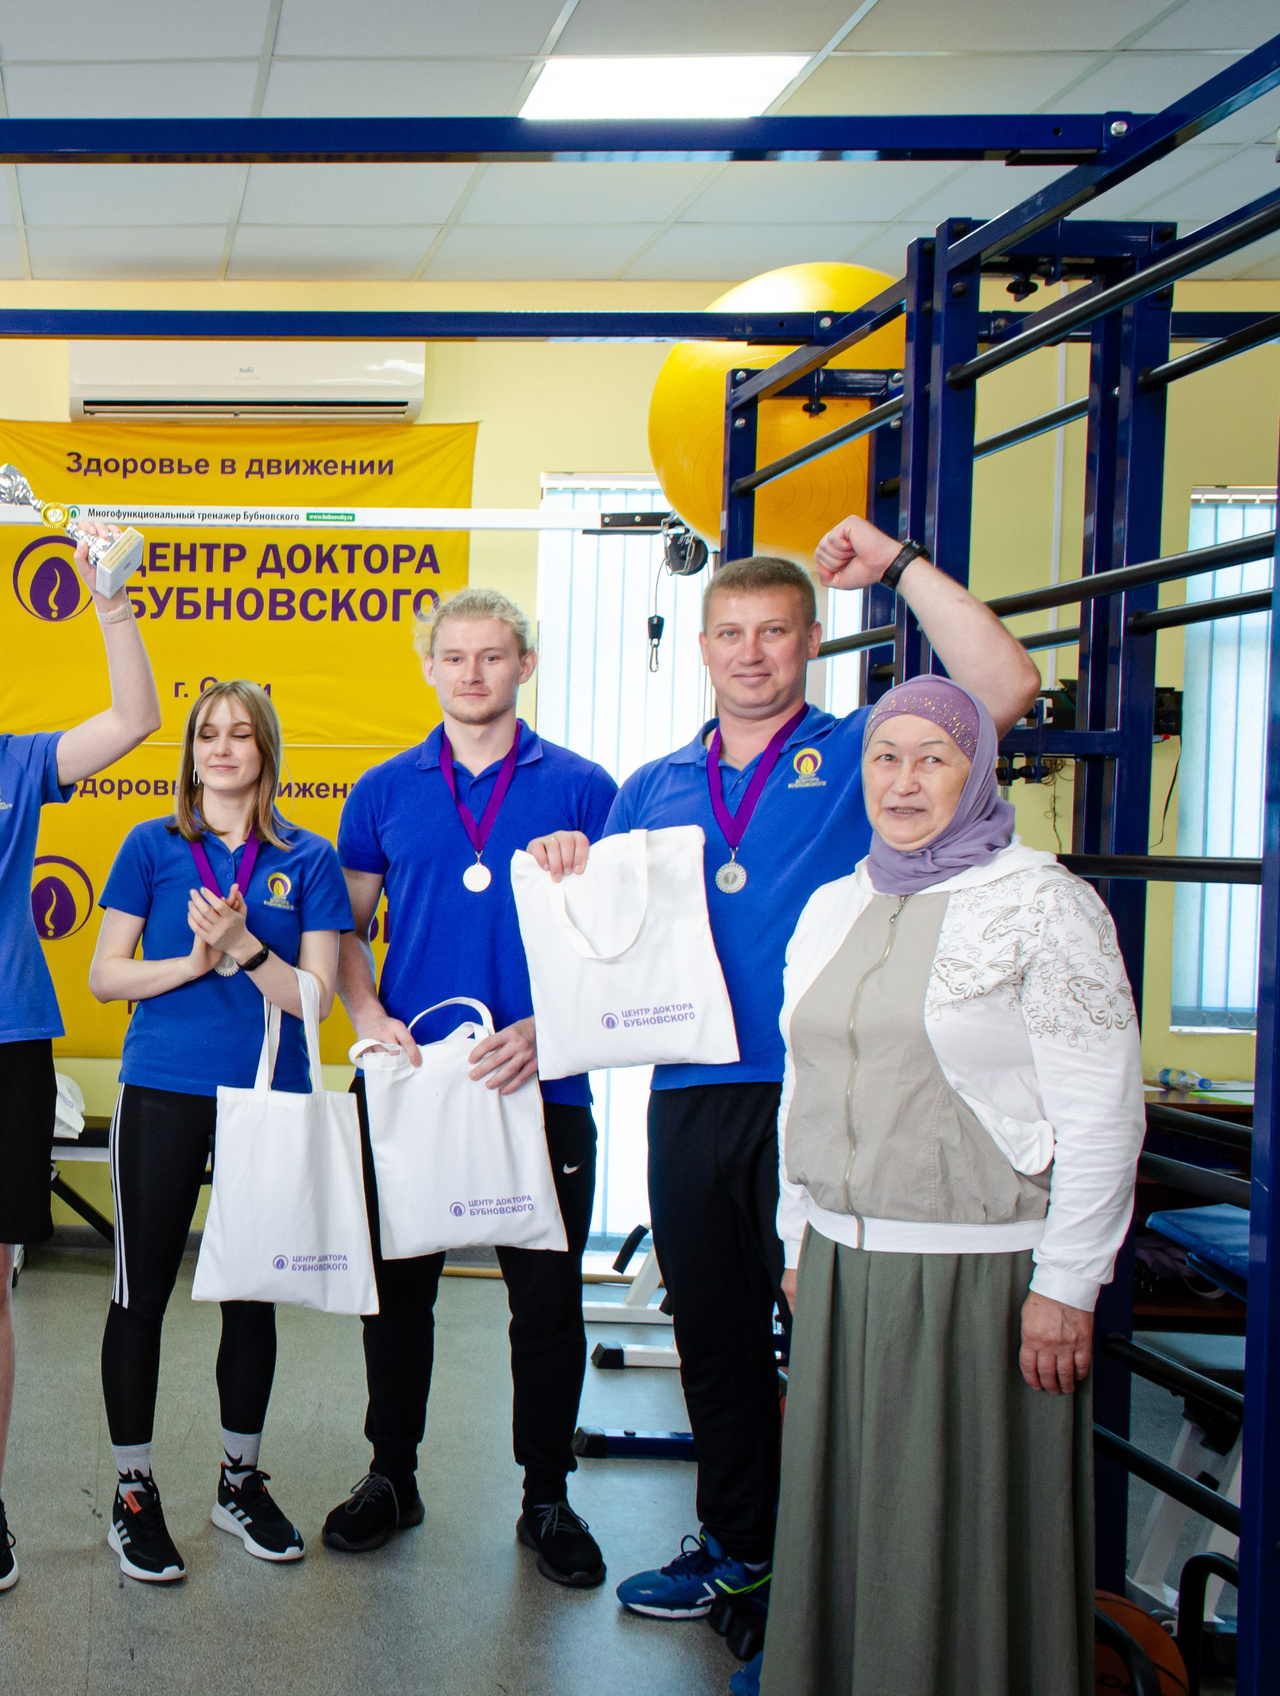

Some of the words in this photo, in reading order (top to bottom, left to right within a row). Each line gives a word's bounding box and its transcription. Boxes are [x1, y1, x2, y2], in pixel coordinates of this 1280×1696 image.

[66, 452, 210, 479] Здоровье
[221, 458, 236, 475] в
[245, 458, 394, 478] движении
[87, 508, 195, 520] Многофункциональный
[197, 512, 241, 522] тренажер
[243, 511, 300, 522] Бубновского
[256, 543, 441, 580] ДОКТОРА
[174, 682, 189, 698] г.
[73, 778, 176, 800] доров
[621, 1007, 650, 1018] ЦЕНТР
[652, 1002, 694, 1015] ДОКТОРА
[623, 1012, 695, 1028] БУБНОВСКОГО
[468, 1199, 493, 1207] ЦЕНТР
[495, 1195, 532, 1206] ДОКТОРА
[469, 1203, 534, 1216] БУБНОВСКОГО
[291, 1263, 348, 1271] БУБНОВСКОГО
[292, 1255, 316, 1263] ЦЕНТР
